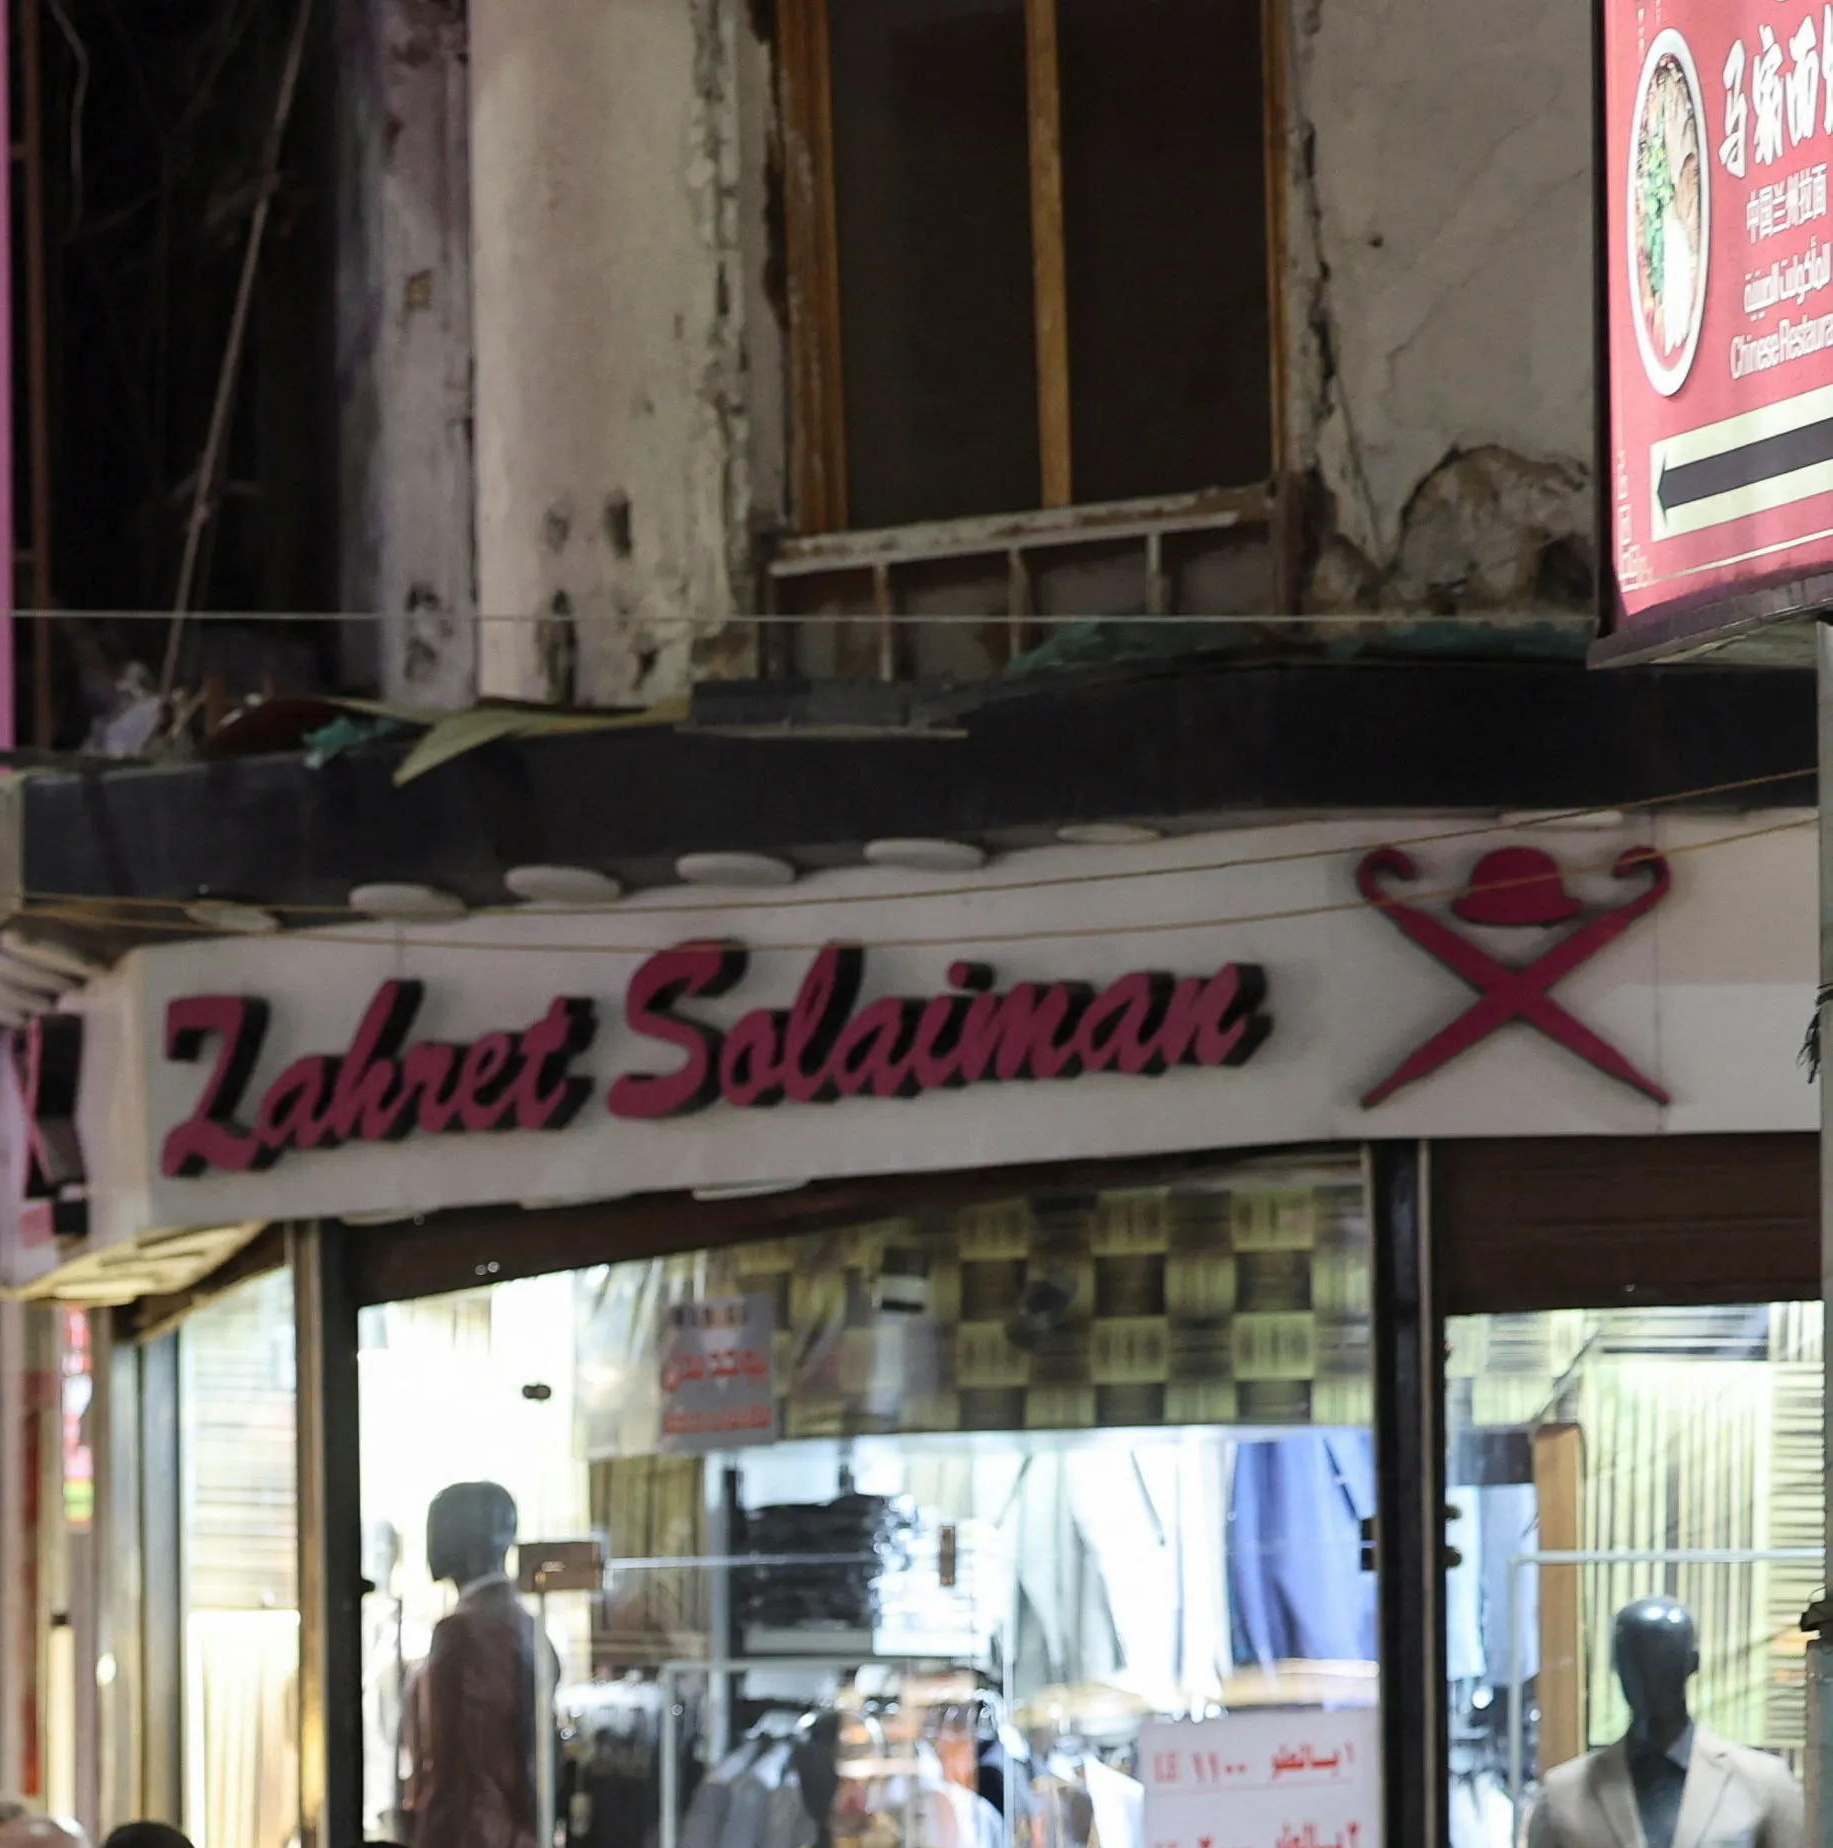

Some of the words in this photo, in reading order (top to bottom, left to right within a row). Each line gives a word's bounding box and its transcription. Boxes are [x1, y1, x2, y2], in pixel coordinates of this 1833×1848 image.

[1729, 333, 1780, 380] Chinese
[161, 979, 595, 1179] Zahret
[606, 939, 1269, 1120] Solaiman
